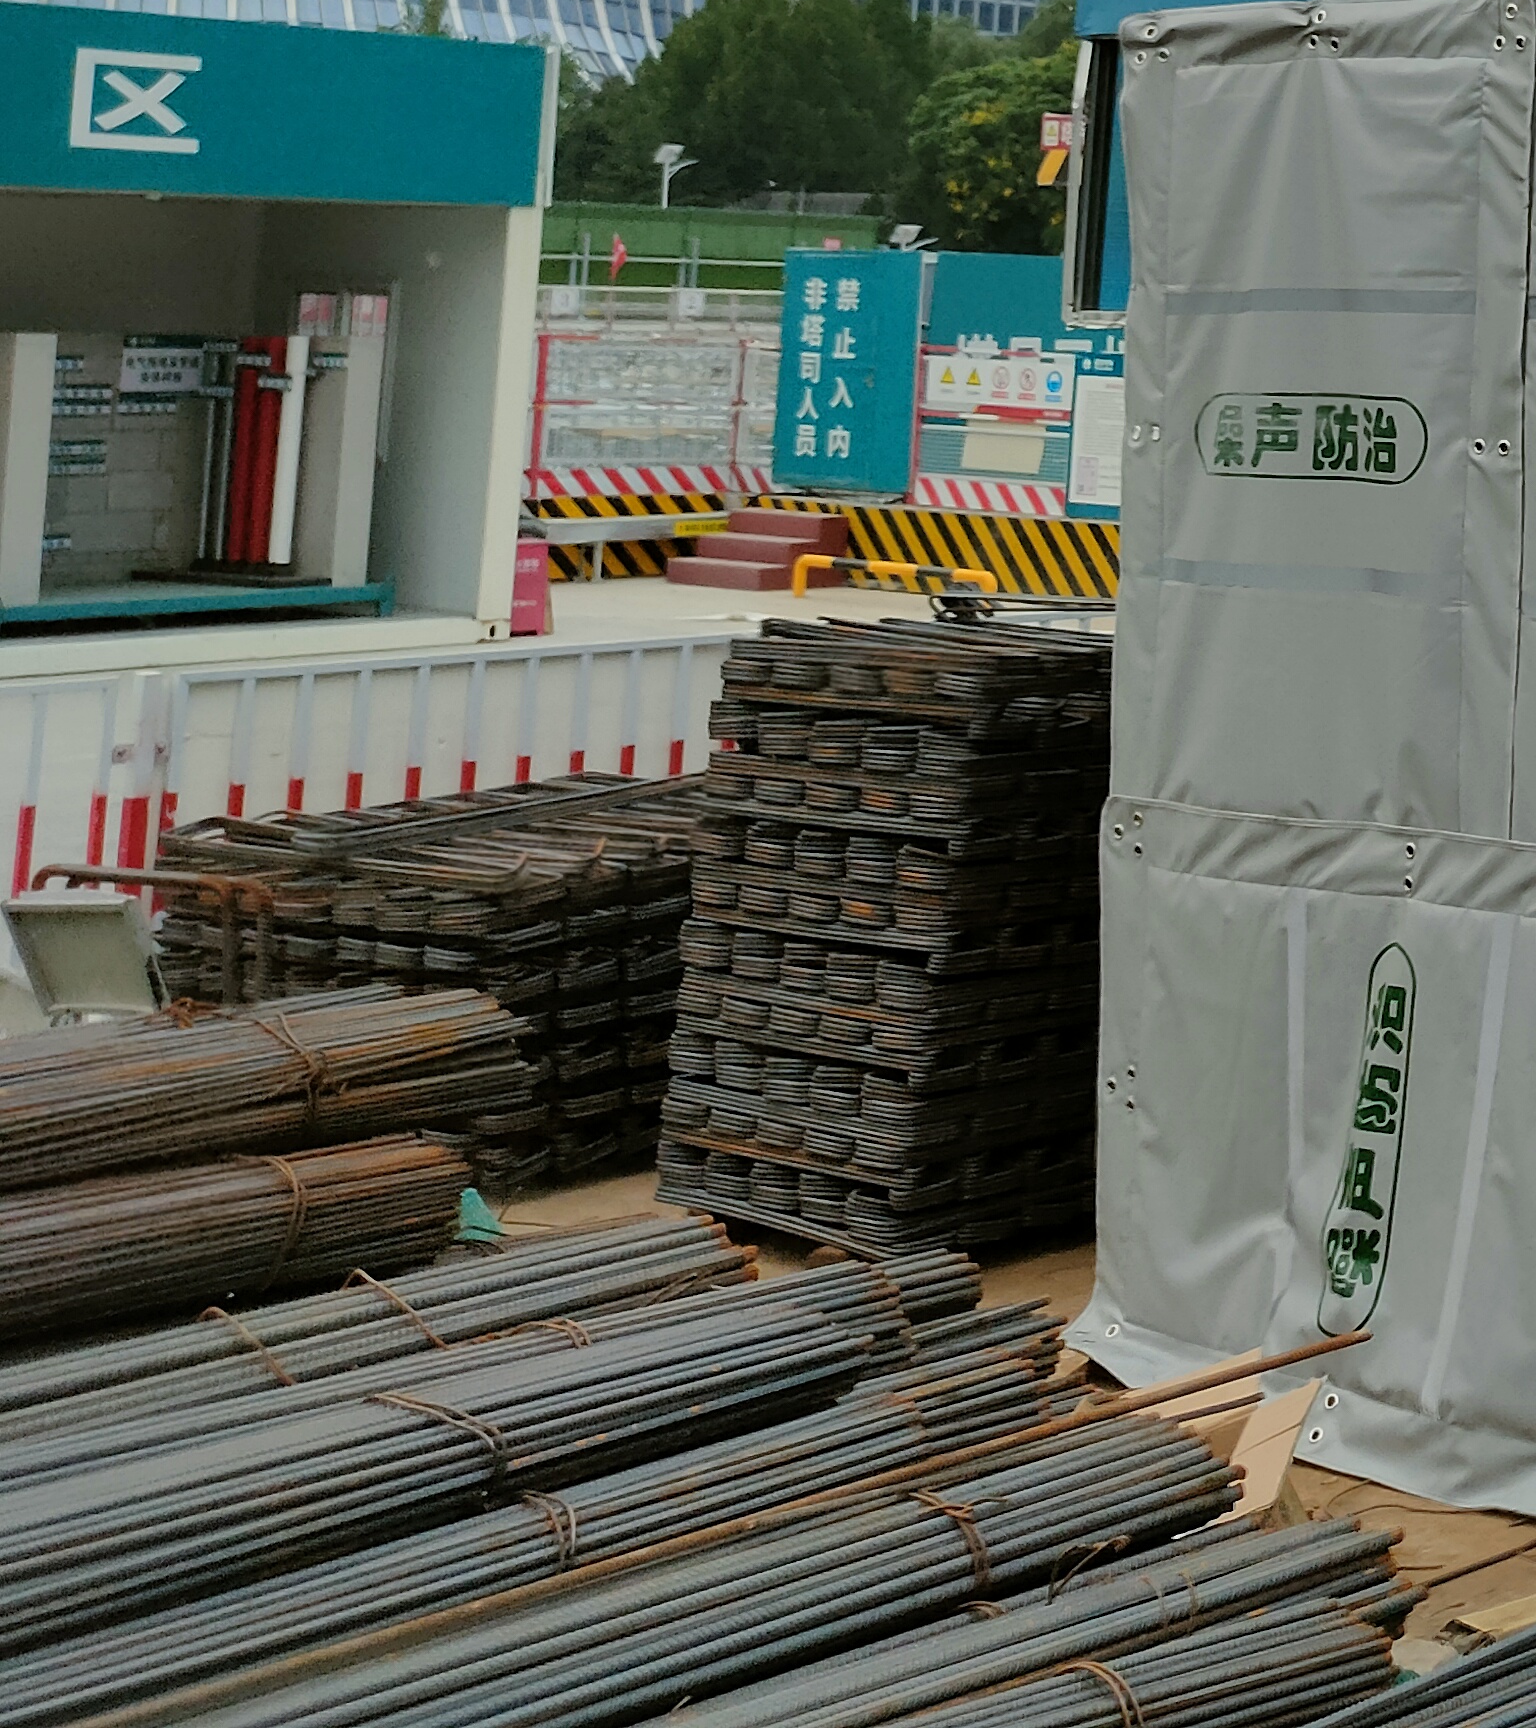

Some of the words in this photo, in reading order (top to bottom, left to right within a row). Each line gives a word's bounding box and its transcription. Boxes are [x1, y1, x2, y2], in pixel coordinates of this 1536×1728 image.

[71, 47, 202, 154] 区
[827, 277, 861, 459] 禁止入内
[1214, 402, 1398, 473] 噪声防治
